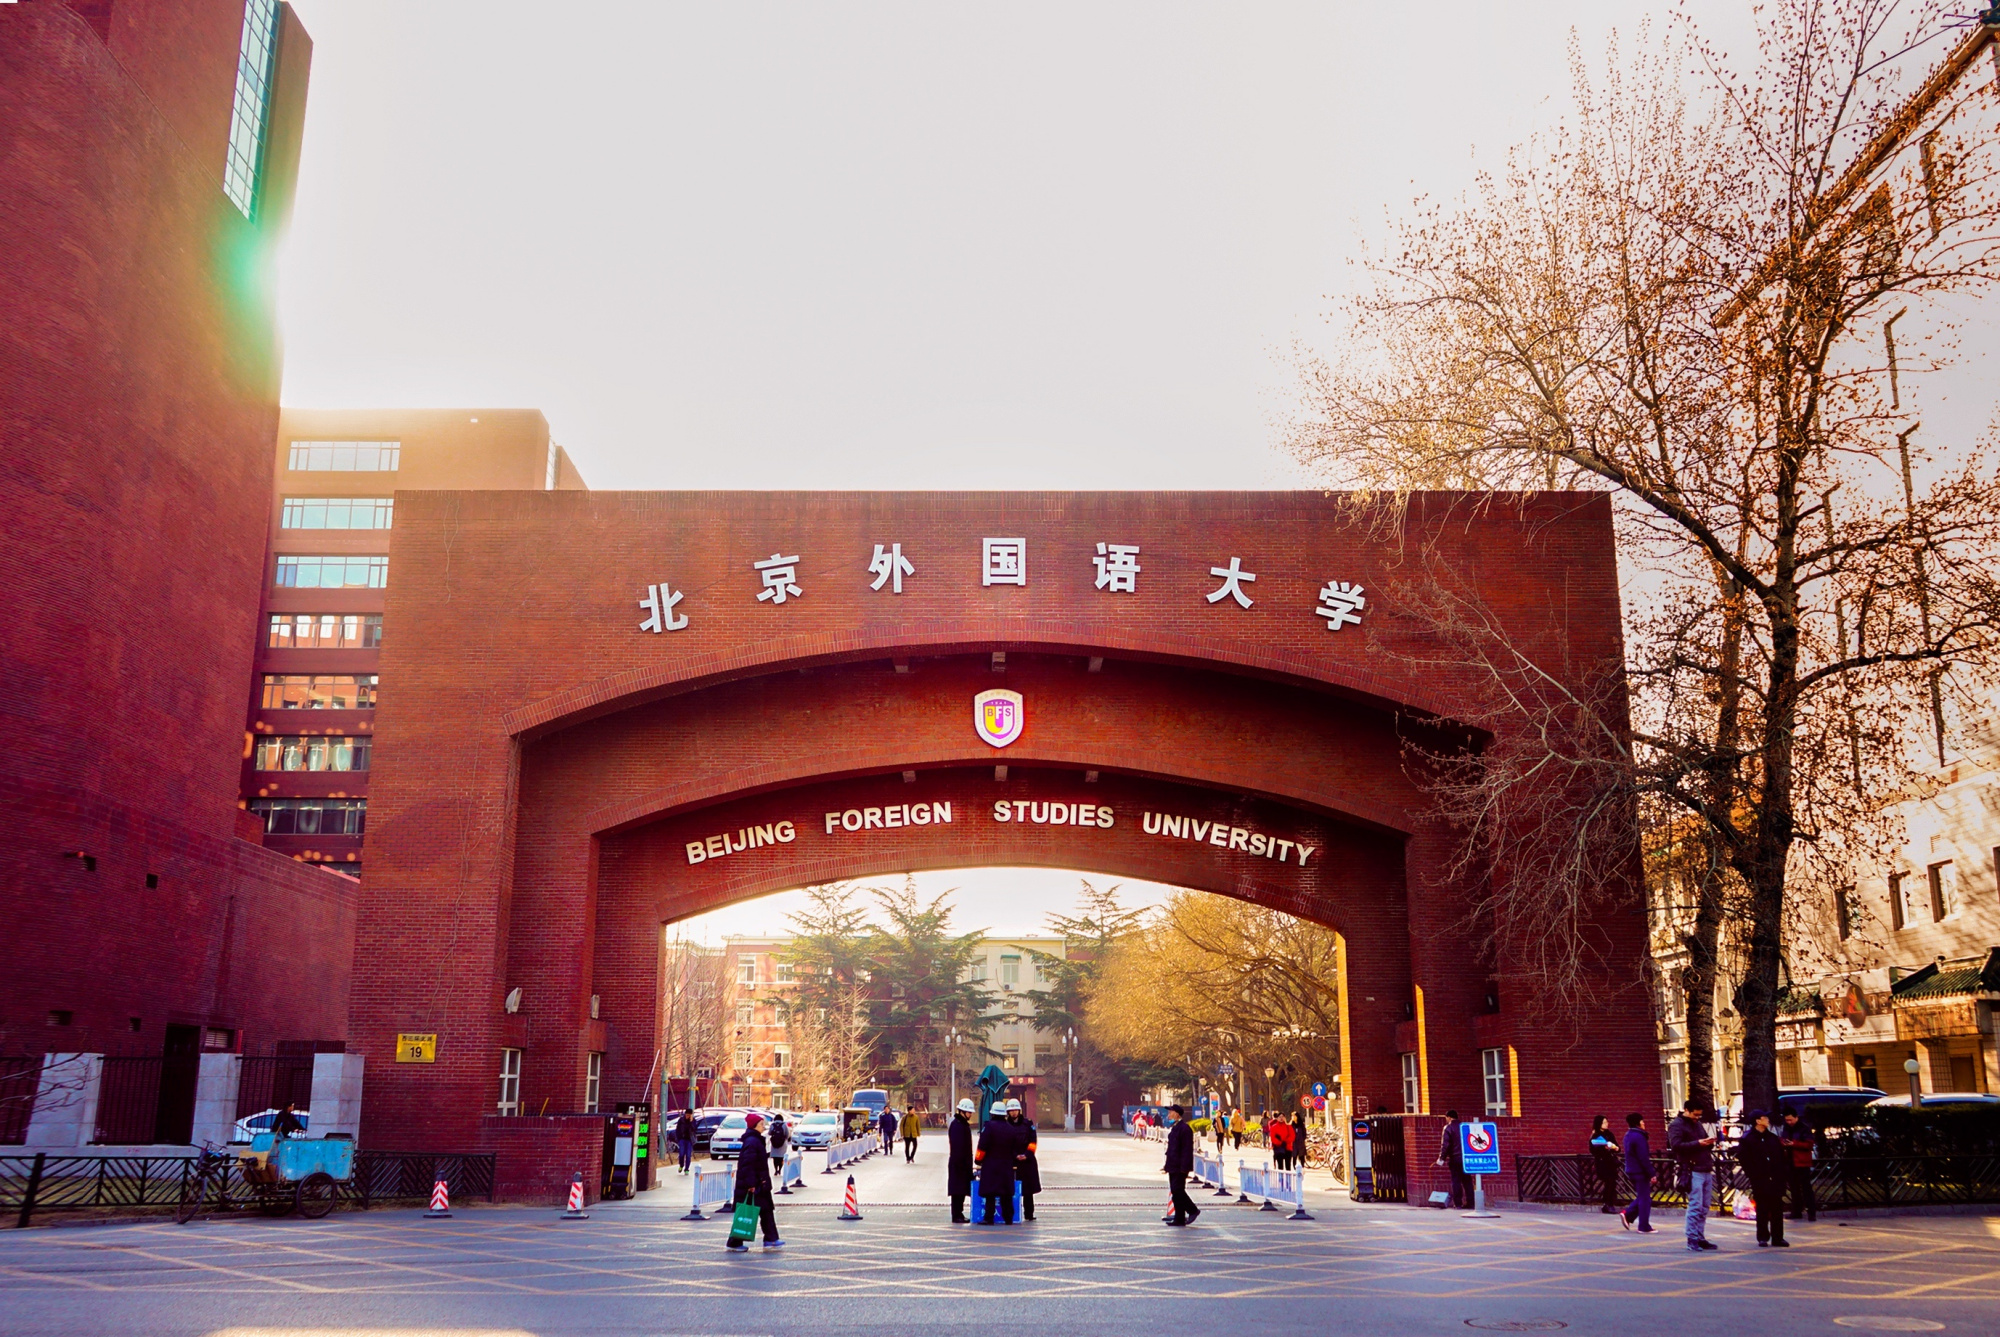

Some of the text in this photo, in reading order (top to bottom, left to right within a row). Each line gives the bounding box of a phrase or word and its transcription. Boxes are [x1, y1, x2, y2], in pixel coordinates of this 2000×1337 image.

[639, 537, 1366, 634] 北京外国语大学
[686, 800, 1316, 866] BEIJING FOREIGN STUDIES UNIVERSITY
[410, 1047, 422, 1058] 19
